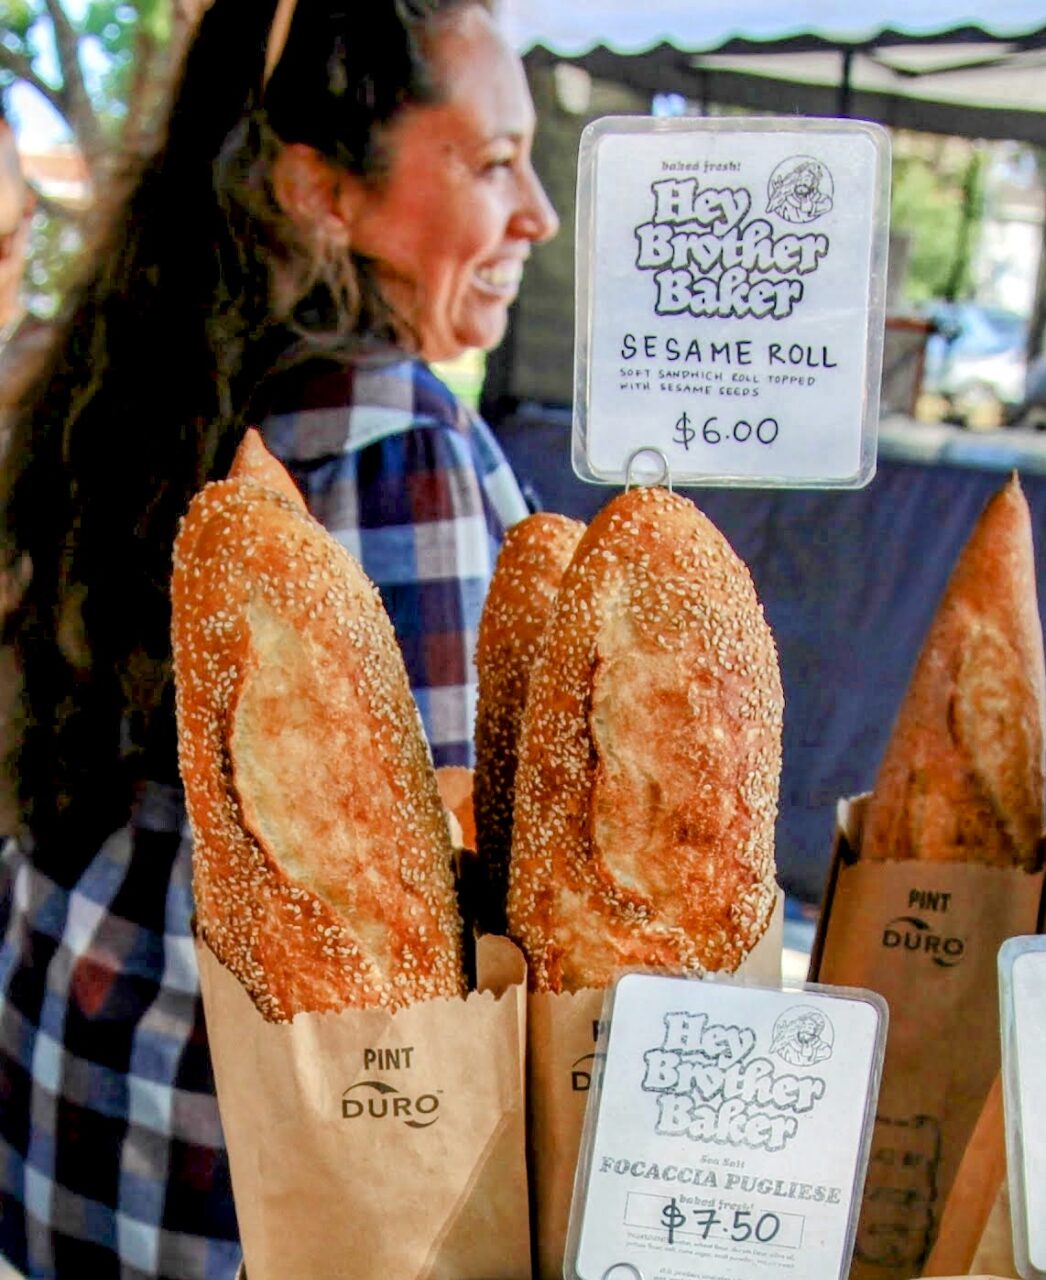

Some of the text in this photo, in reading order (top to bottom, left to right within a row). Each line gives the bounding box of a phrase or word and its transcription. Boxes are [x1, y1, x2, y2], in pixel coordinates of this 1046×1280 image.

[661, 160, 741, 173] baked fresh!
[650, 177, 751, 231] Hey
[634, 219, 829, 273] Brother
[654, 265, 803, 319] Baker
[621, 333, 838, 368] SESAME ROLL
[619, 368, 650, 378] SOFT
[732, 373, 760, 383] ROLL
[768, 375, 816, 386] TOPPED
[620, 382, 759, 396] WITH SESAME SEEDS
[672, 411, 779, 450] $6.00
[908, 888, 952, 913] PINT
[882, 929, 964, 957] DURO
[364, 1047, 414, 1070] PINT
[663, 1011, 757, 1067] Hey
[642, 1049, 827, 1114] Brother
[342, 1093, 440, 1119] DURO
[655, 1092, 798, 1152] Baker
[599, 1155, 842, 1205] FOCACCIA PUGLIESE
[661, 1198, 780, 1244] $7.50
